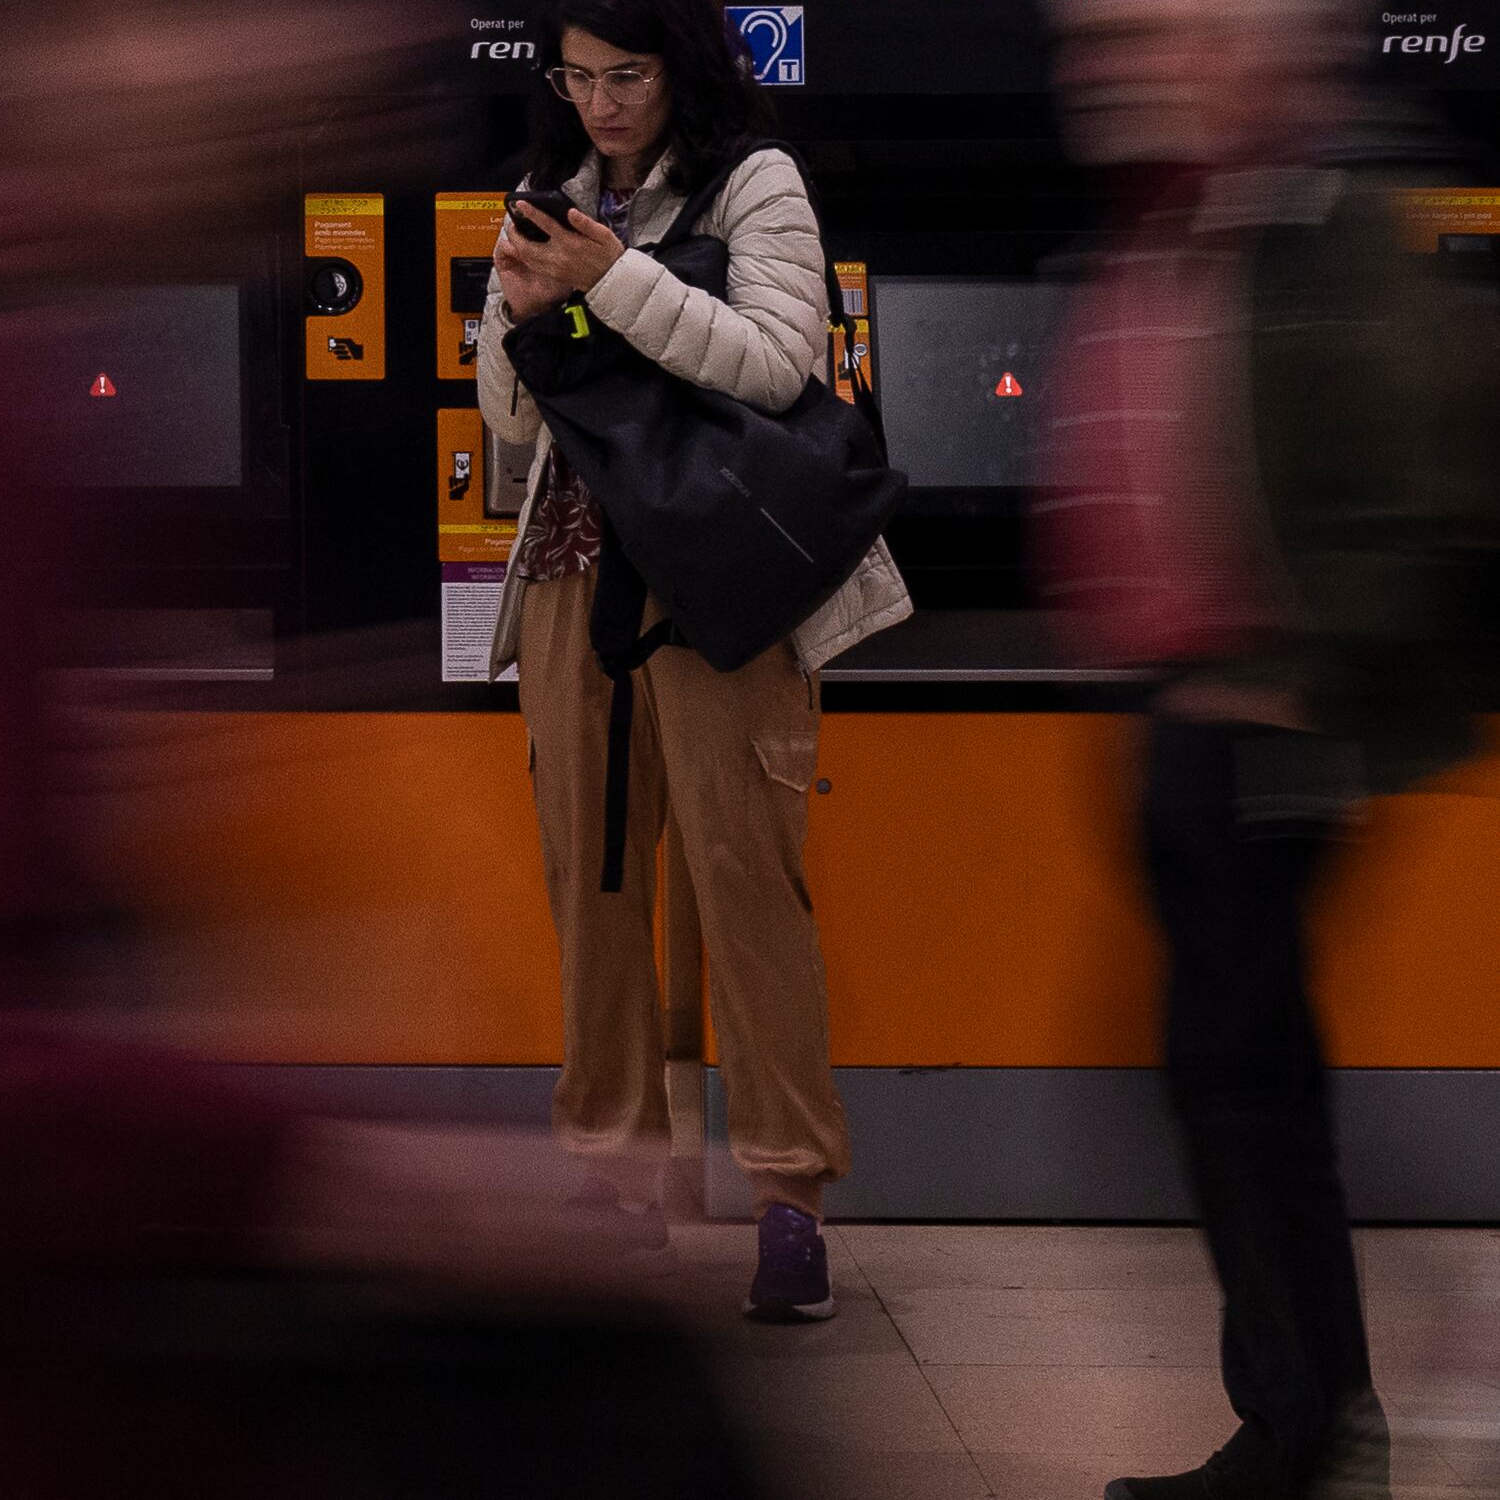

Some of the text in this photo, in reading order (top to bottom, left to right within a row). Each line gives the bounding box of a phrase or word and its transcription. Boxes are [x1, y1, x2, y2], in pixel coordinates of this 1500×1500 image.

[471, 18, 524, 30] Operat per
[1382, 12, 1436, 25] Operat per
[1382, 24, 1485, 63] renfe
